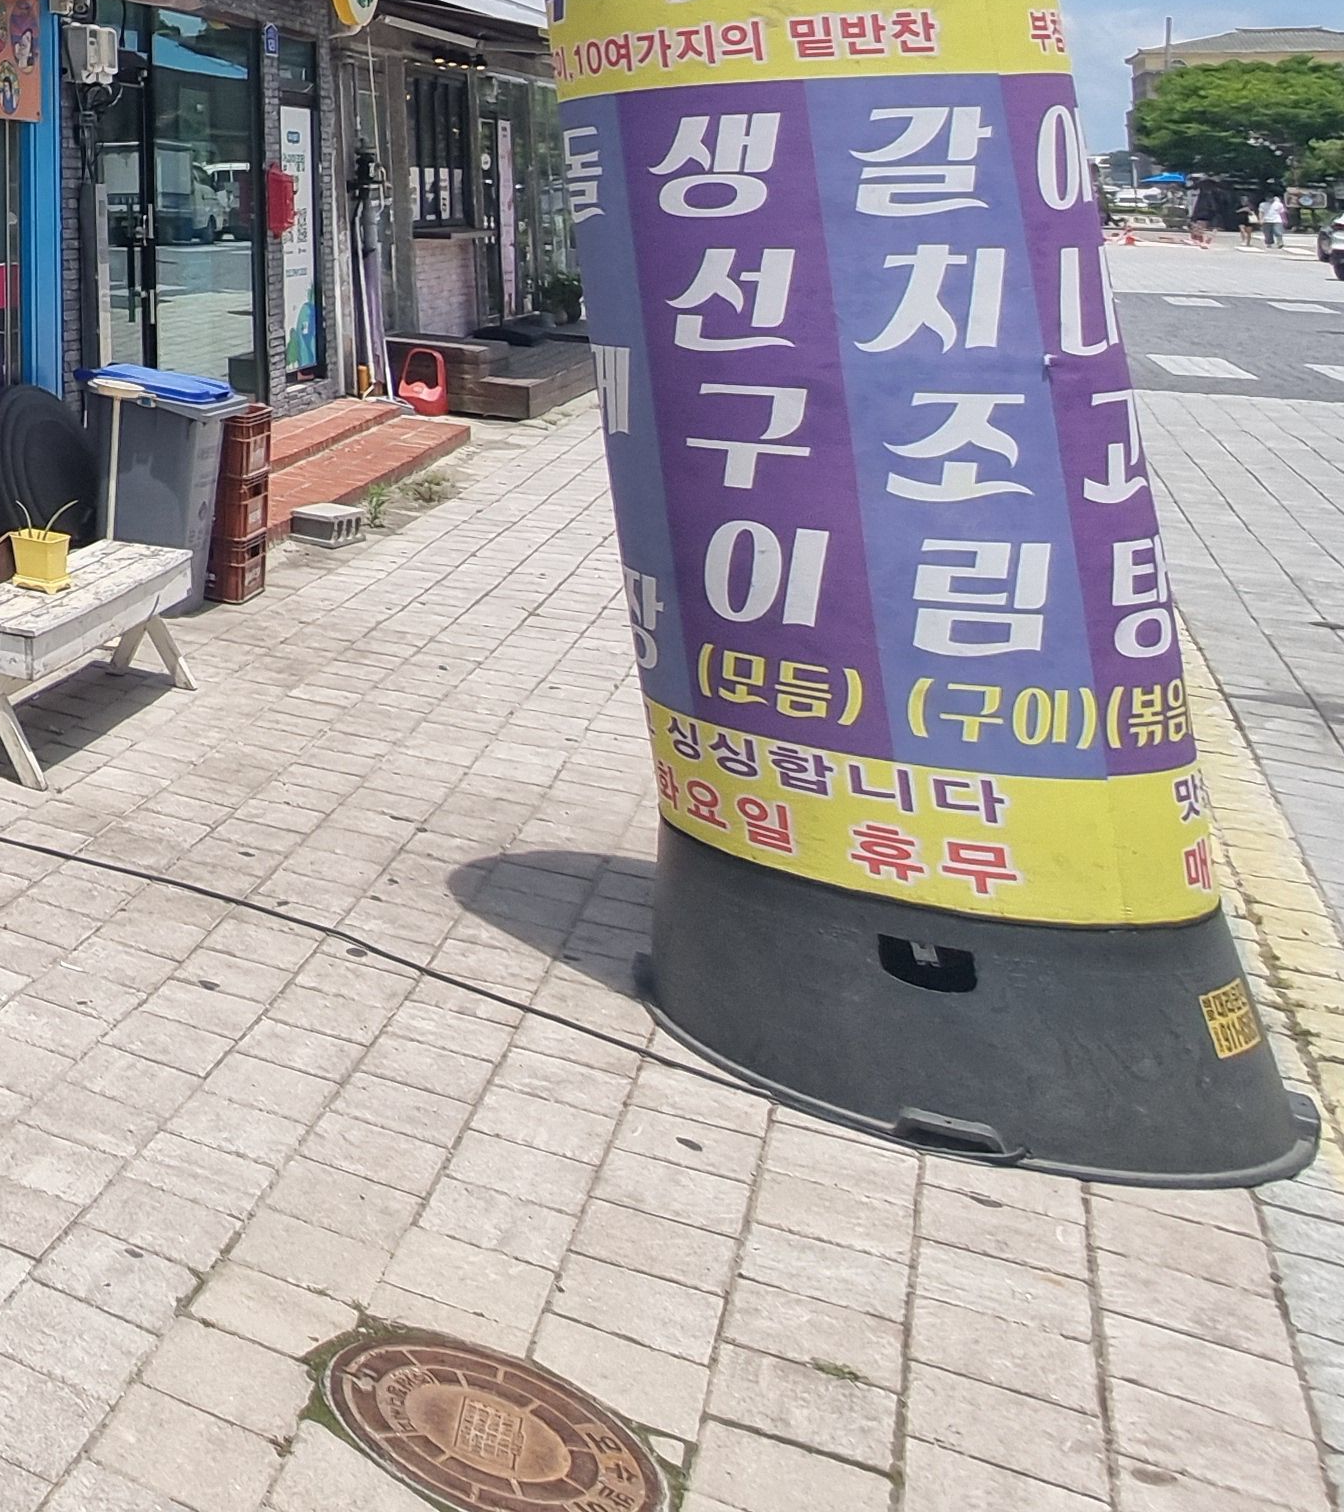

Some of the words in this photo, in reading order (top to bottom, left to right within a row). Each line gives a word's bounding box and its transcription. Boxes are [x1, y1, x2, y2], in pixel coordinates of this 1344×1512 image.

[788, 10, 938, 60] 밑반찬
[647, 111, 831, 626] 생선구이
[849, 105, 1051, 657] 갈치조림
[698, 643, 863, 726] (모듬)
[906, 676, 1096, 751] (구이)
[666, 716, 1009, 825] 싱싱합니다
[849, 823, 1018, 894] 휴무
